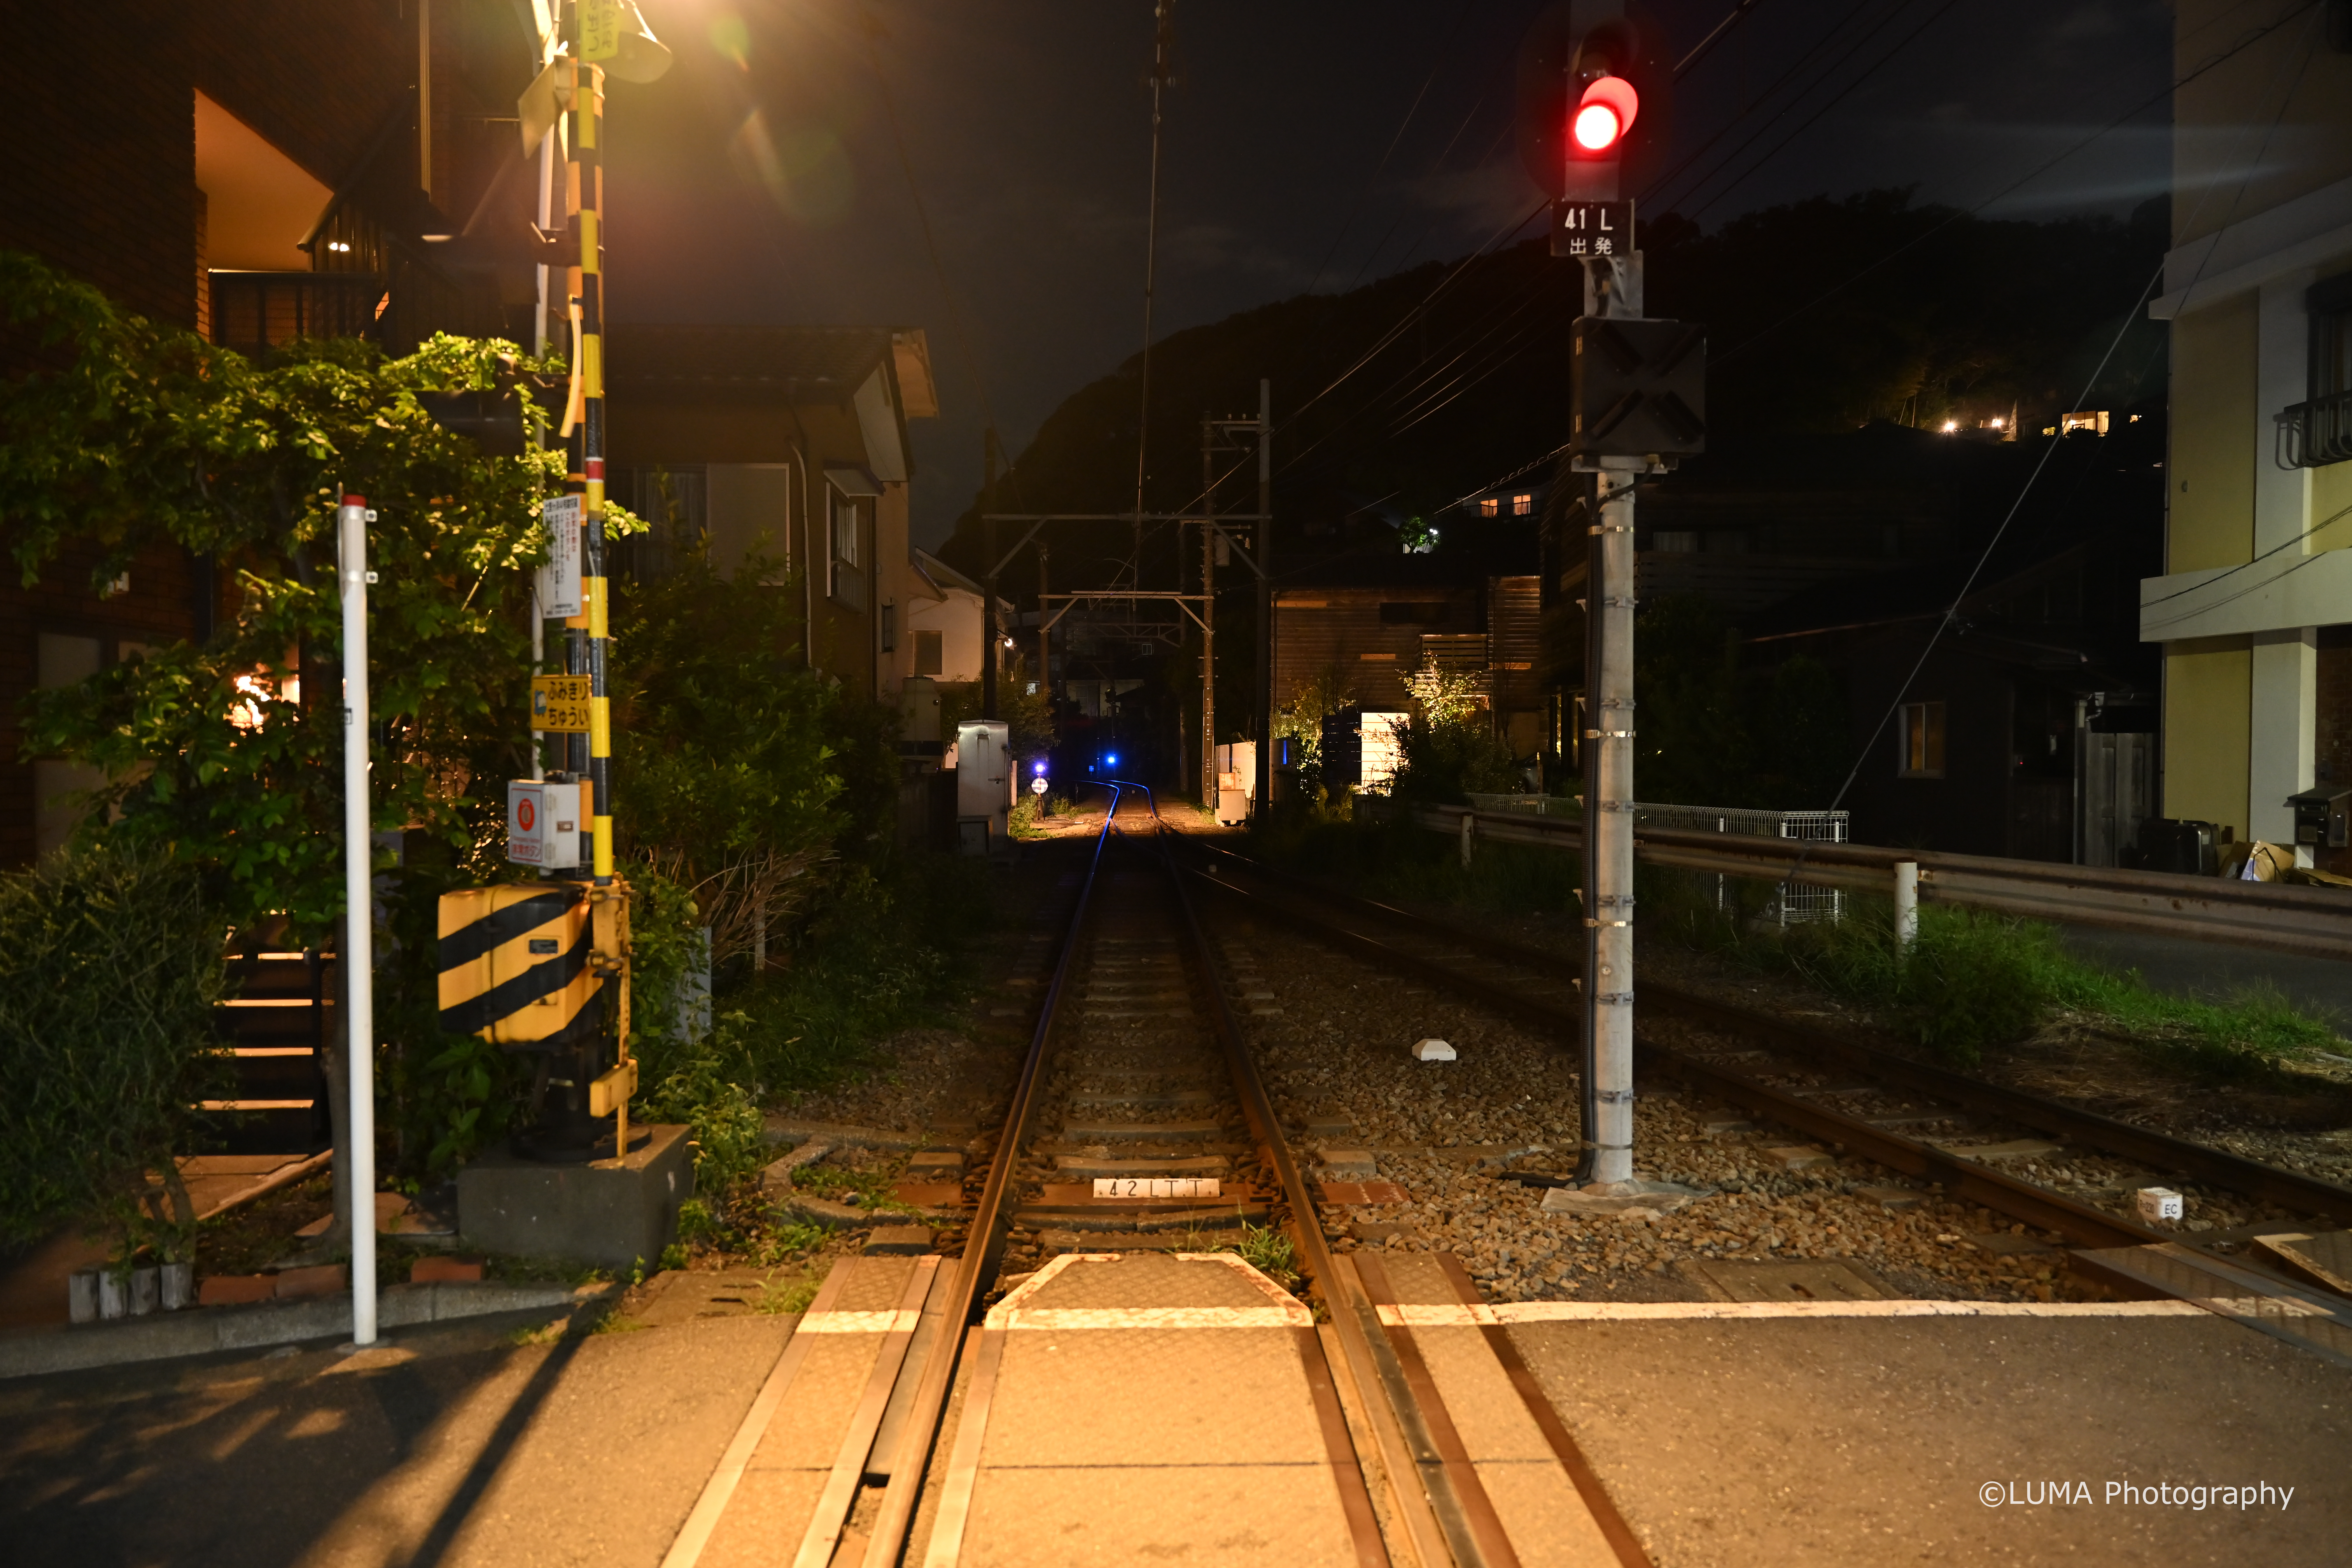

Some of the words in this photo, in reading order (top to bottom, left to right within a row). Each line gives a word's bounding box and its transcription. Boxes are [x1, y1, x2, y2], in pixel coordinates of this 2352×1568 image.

[1565, 208, 1586, 229] 41
[1601, 208, 1613, 230] L
[1570, 236, 1613, 255] 出発
[548, 681, 588, 700] ふみきり
[549, 706, 589, 726] ちゅうい
[2165, 1204, 2177, 1214] EC
